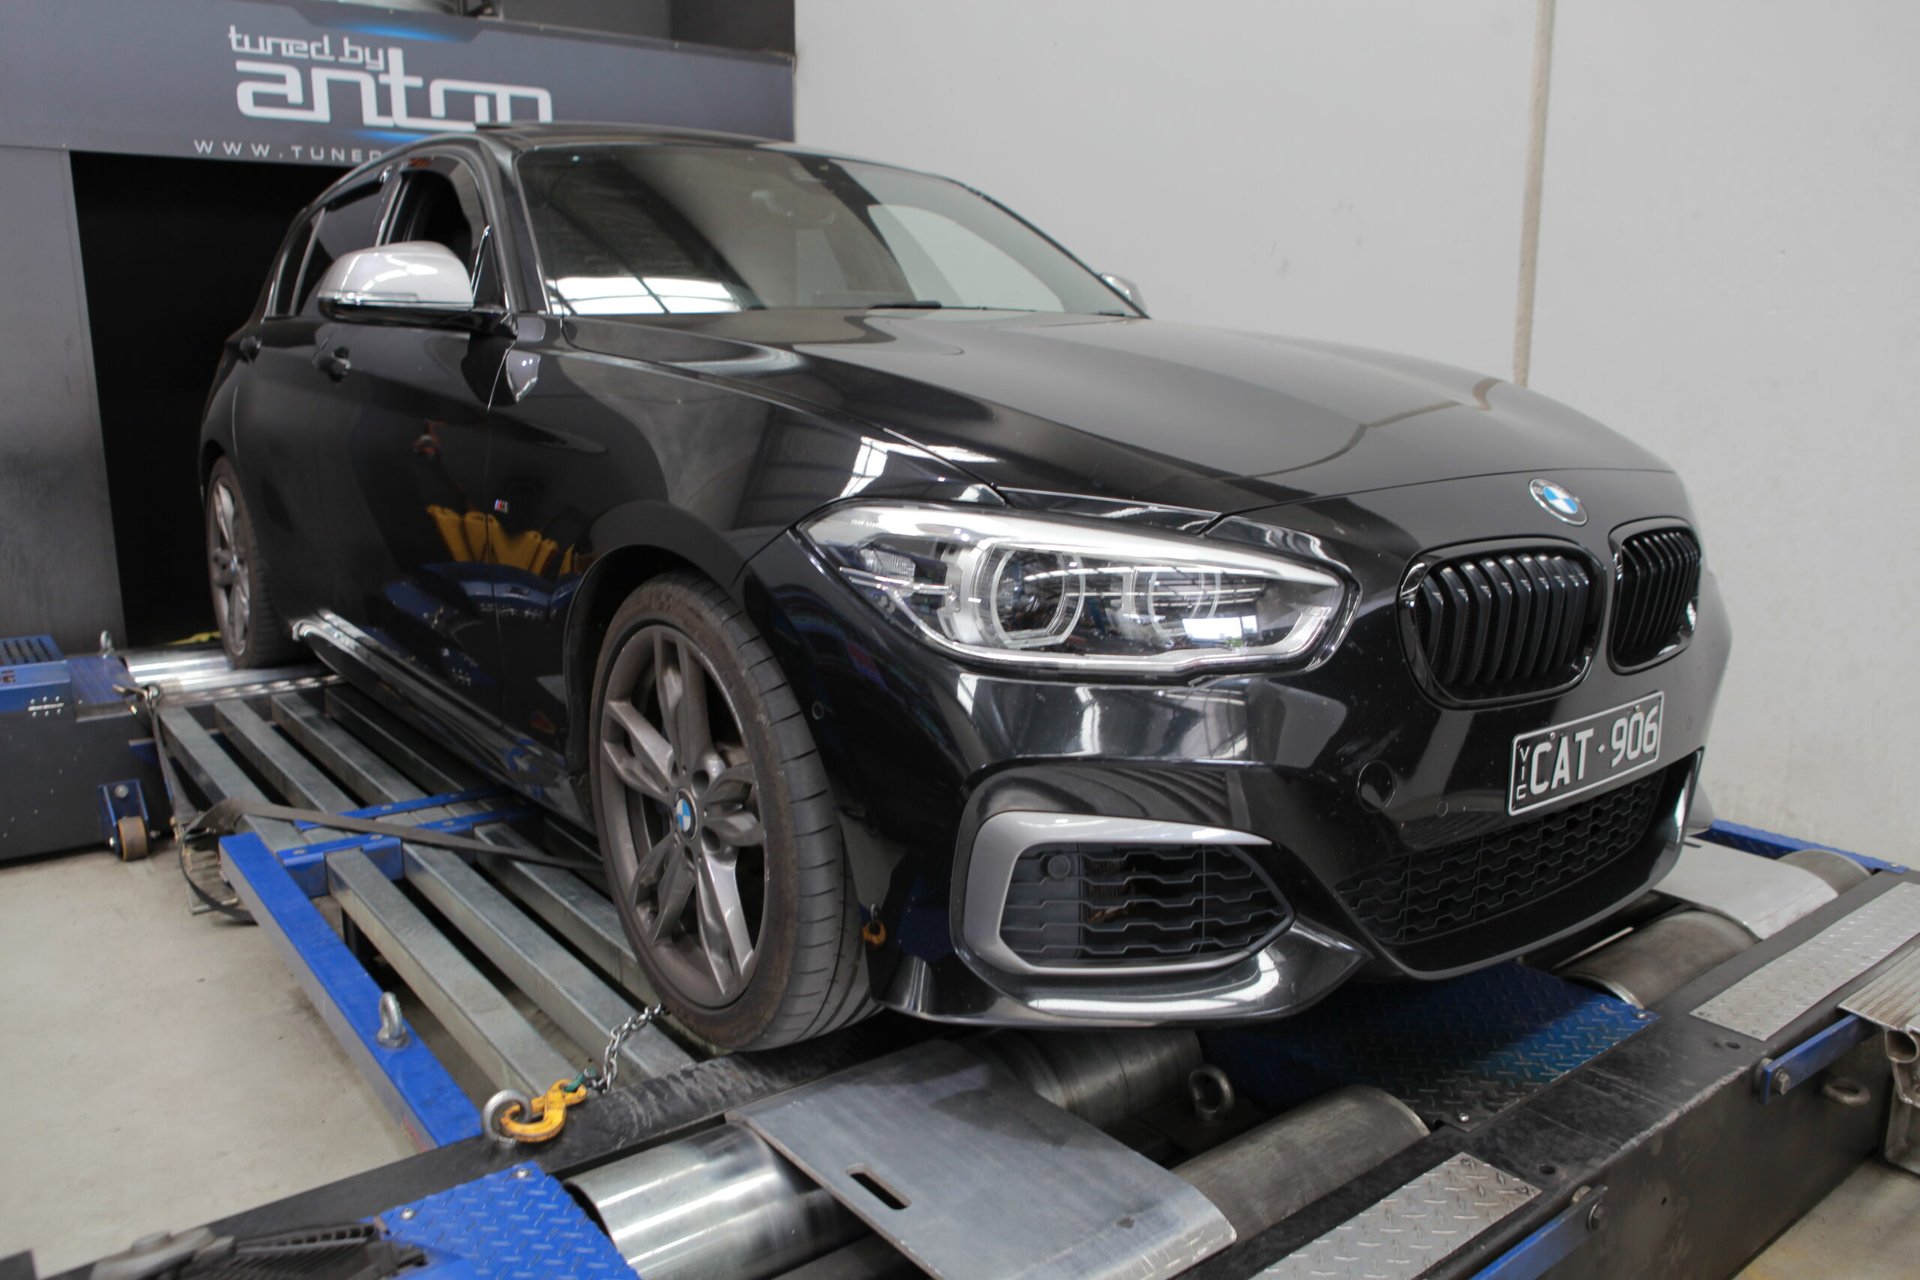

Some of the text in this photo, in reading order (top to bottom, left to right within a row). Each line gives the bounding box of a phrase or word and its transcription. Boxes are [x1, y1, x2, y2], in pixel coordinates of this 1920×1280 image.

[229, 24, 385, 71] tuned by
[1516, 746, 1529, 800] VIC
